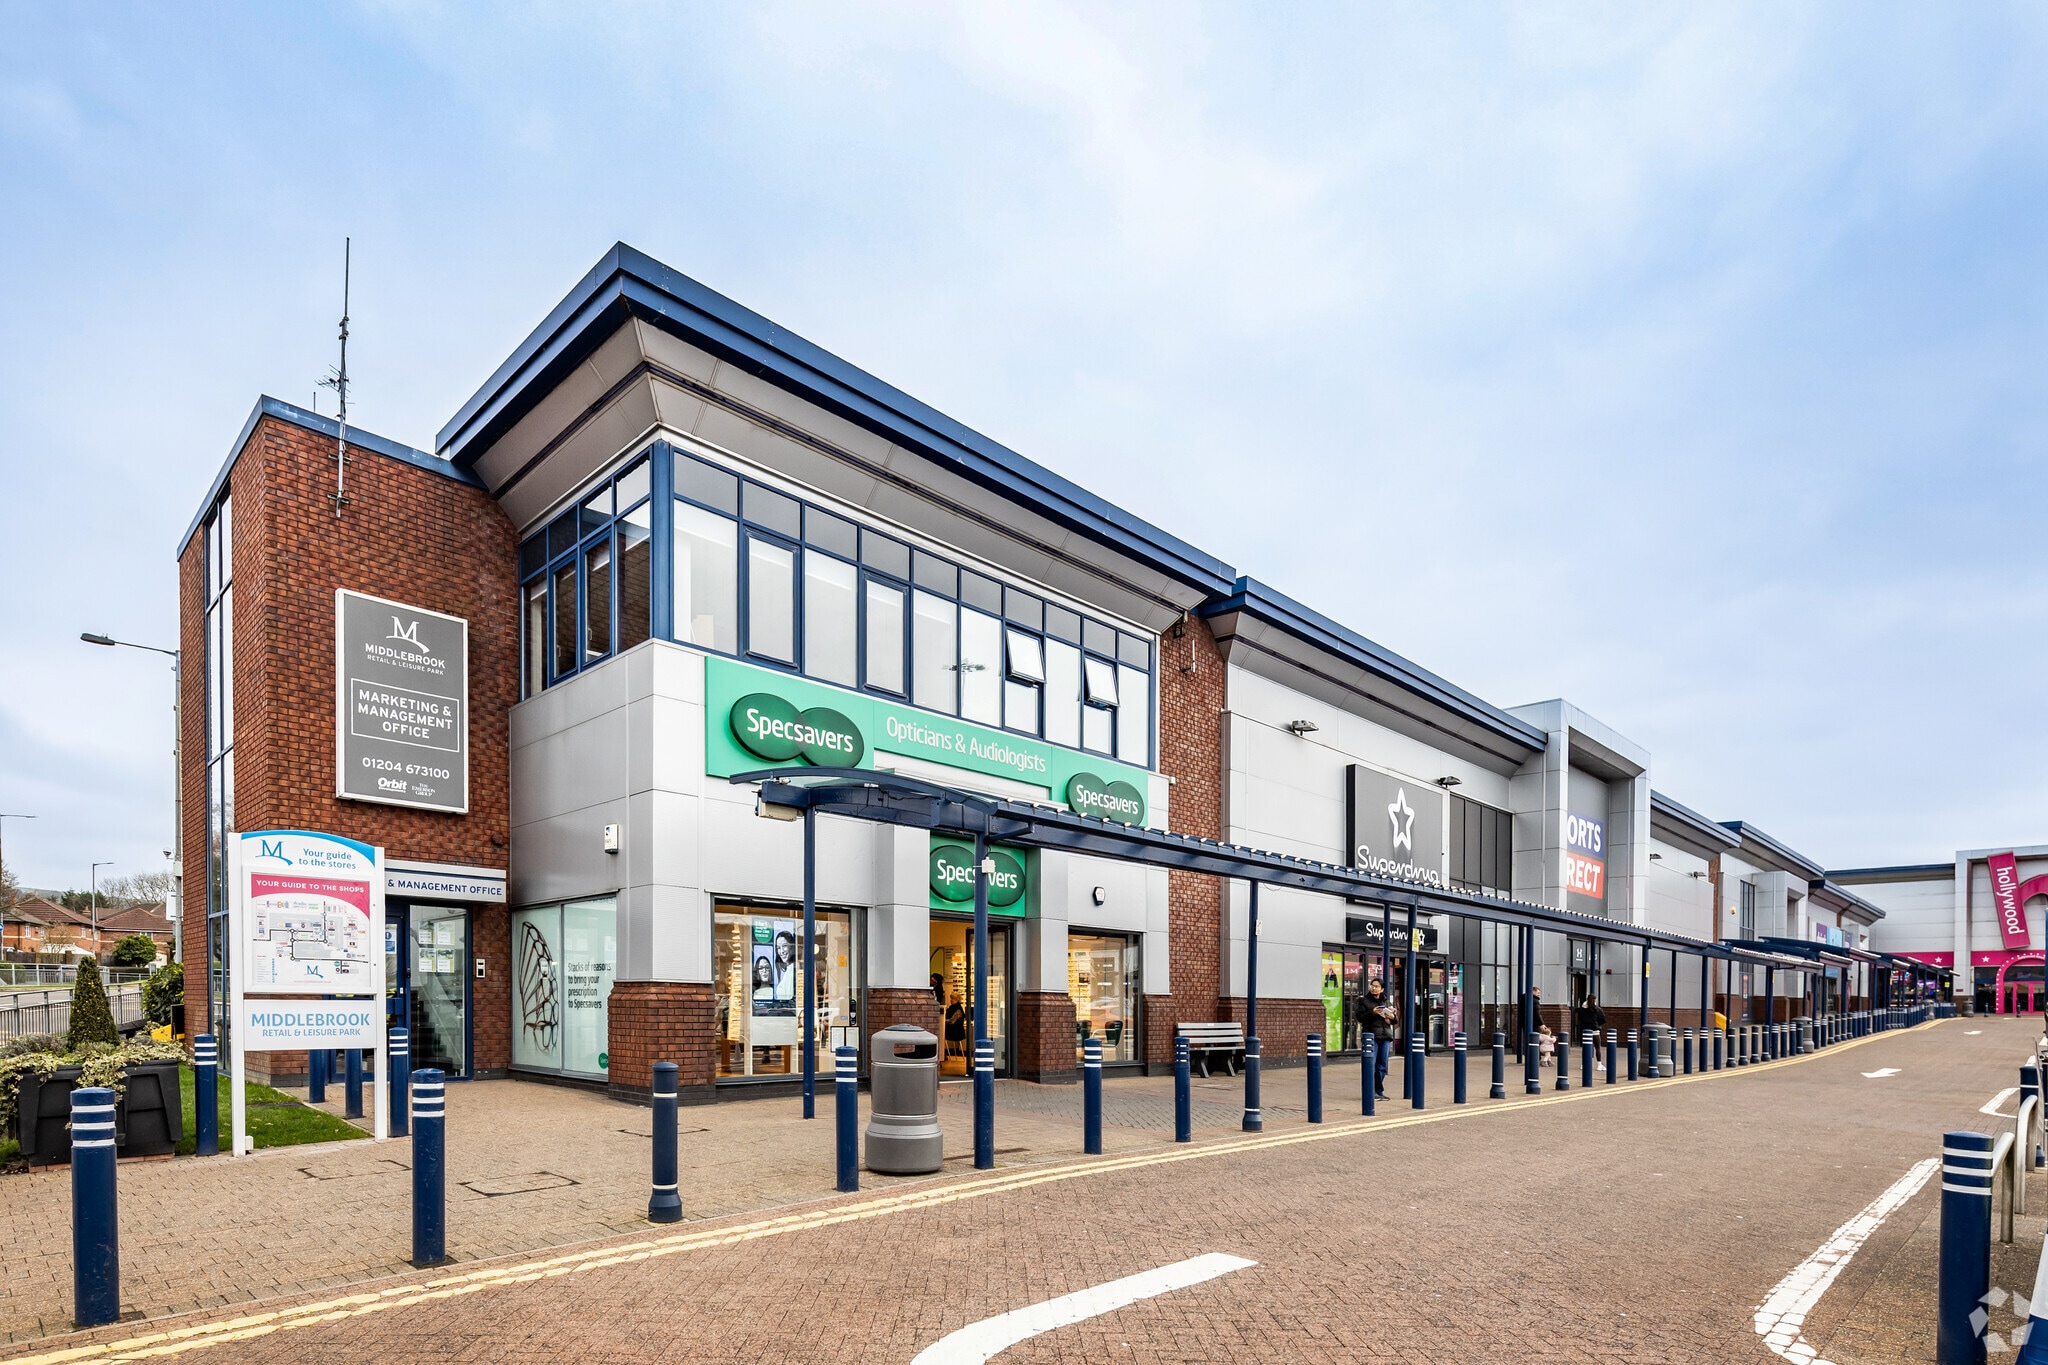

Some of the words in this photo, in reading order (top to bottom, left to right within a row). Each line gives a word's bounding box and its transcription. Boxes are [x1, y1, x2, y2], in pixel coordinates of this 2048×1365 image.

[365, 643, 446, 668] MIDDLEBROOK
[367, 654, 390, 665] RETAIL
[398, 661, 425, 672] LEISURE
[427, 667, 444, 675] PARK
[359, 689, 439, 714] MARKETING
[442, 706, 451, 717] &
[358, 702, 453, 729] MANAGEMENT
[382, 721, 430, 739] OFFICE
[746, 708, 853, 753] Specsavers
[886, 716, 952, 750] Opticians
[955, 733, 966, 754] &
[969, 737, 1046, 772] Audiologists
[362, 757, 402, 772] 01204
[405, 764, 450, 779] 673100
[377, 777, 407, 790] Orbit
[1076, 784, 1139, 815] Specsavers
[1567, 814, 1601, 853] ORTS
[303, 848, 323, 857] Your
[326, 851, 352, 861] guide
[311, 858, 326, 866] the
[328, 861, 356, 870] stores
[1357, 845, 1440, 885] Superdrug
[937, 859, 1017, 889] Specvers
[1567, 857, 1600, 893] RECT
[387, 879, 395, 888] &
[397, 880, 467, 893] MANAGEMENT
[469, 886, 502, 896] OFFICE
[1996, 866, 2025, 934] hollywood
[568, 962, 584, 972] Stacks
[584, 962, 590, 971] of
[591, 963, 611, 972] reasons
[568, 976, 573, 984] to
[574, 975, 587, 987] bring
[587, 976, 600, 987] your
[568, 987, 597, 998] prescription
[568, 1000, 573, 1008] to
[573, 999, 602, 1011] Specsavers
[251, 1013, 370, 1027] MIDDLEBROOK
[262, 1029, 292, 1037] RETAIL
[303, 1028, 337, 1036] LEISURE
[339, 1028, 361, 1036] PARK
